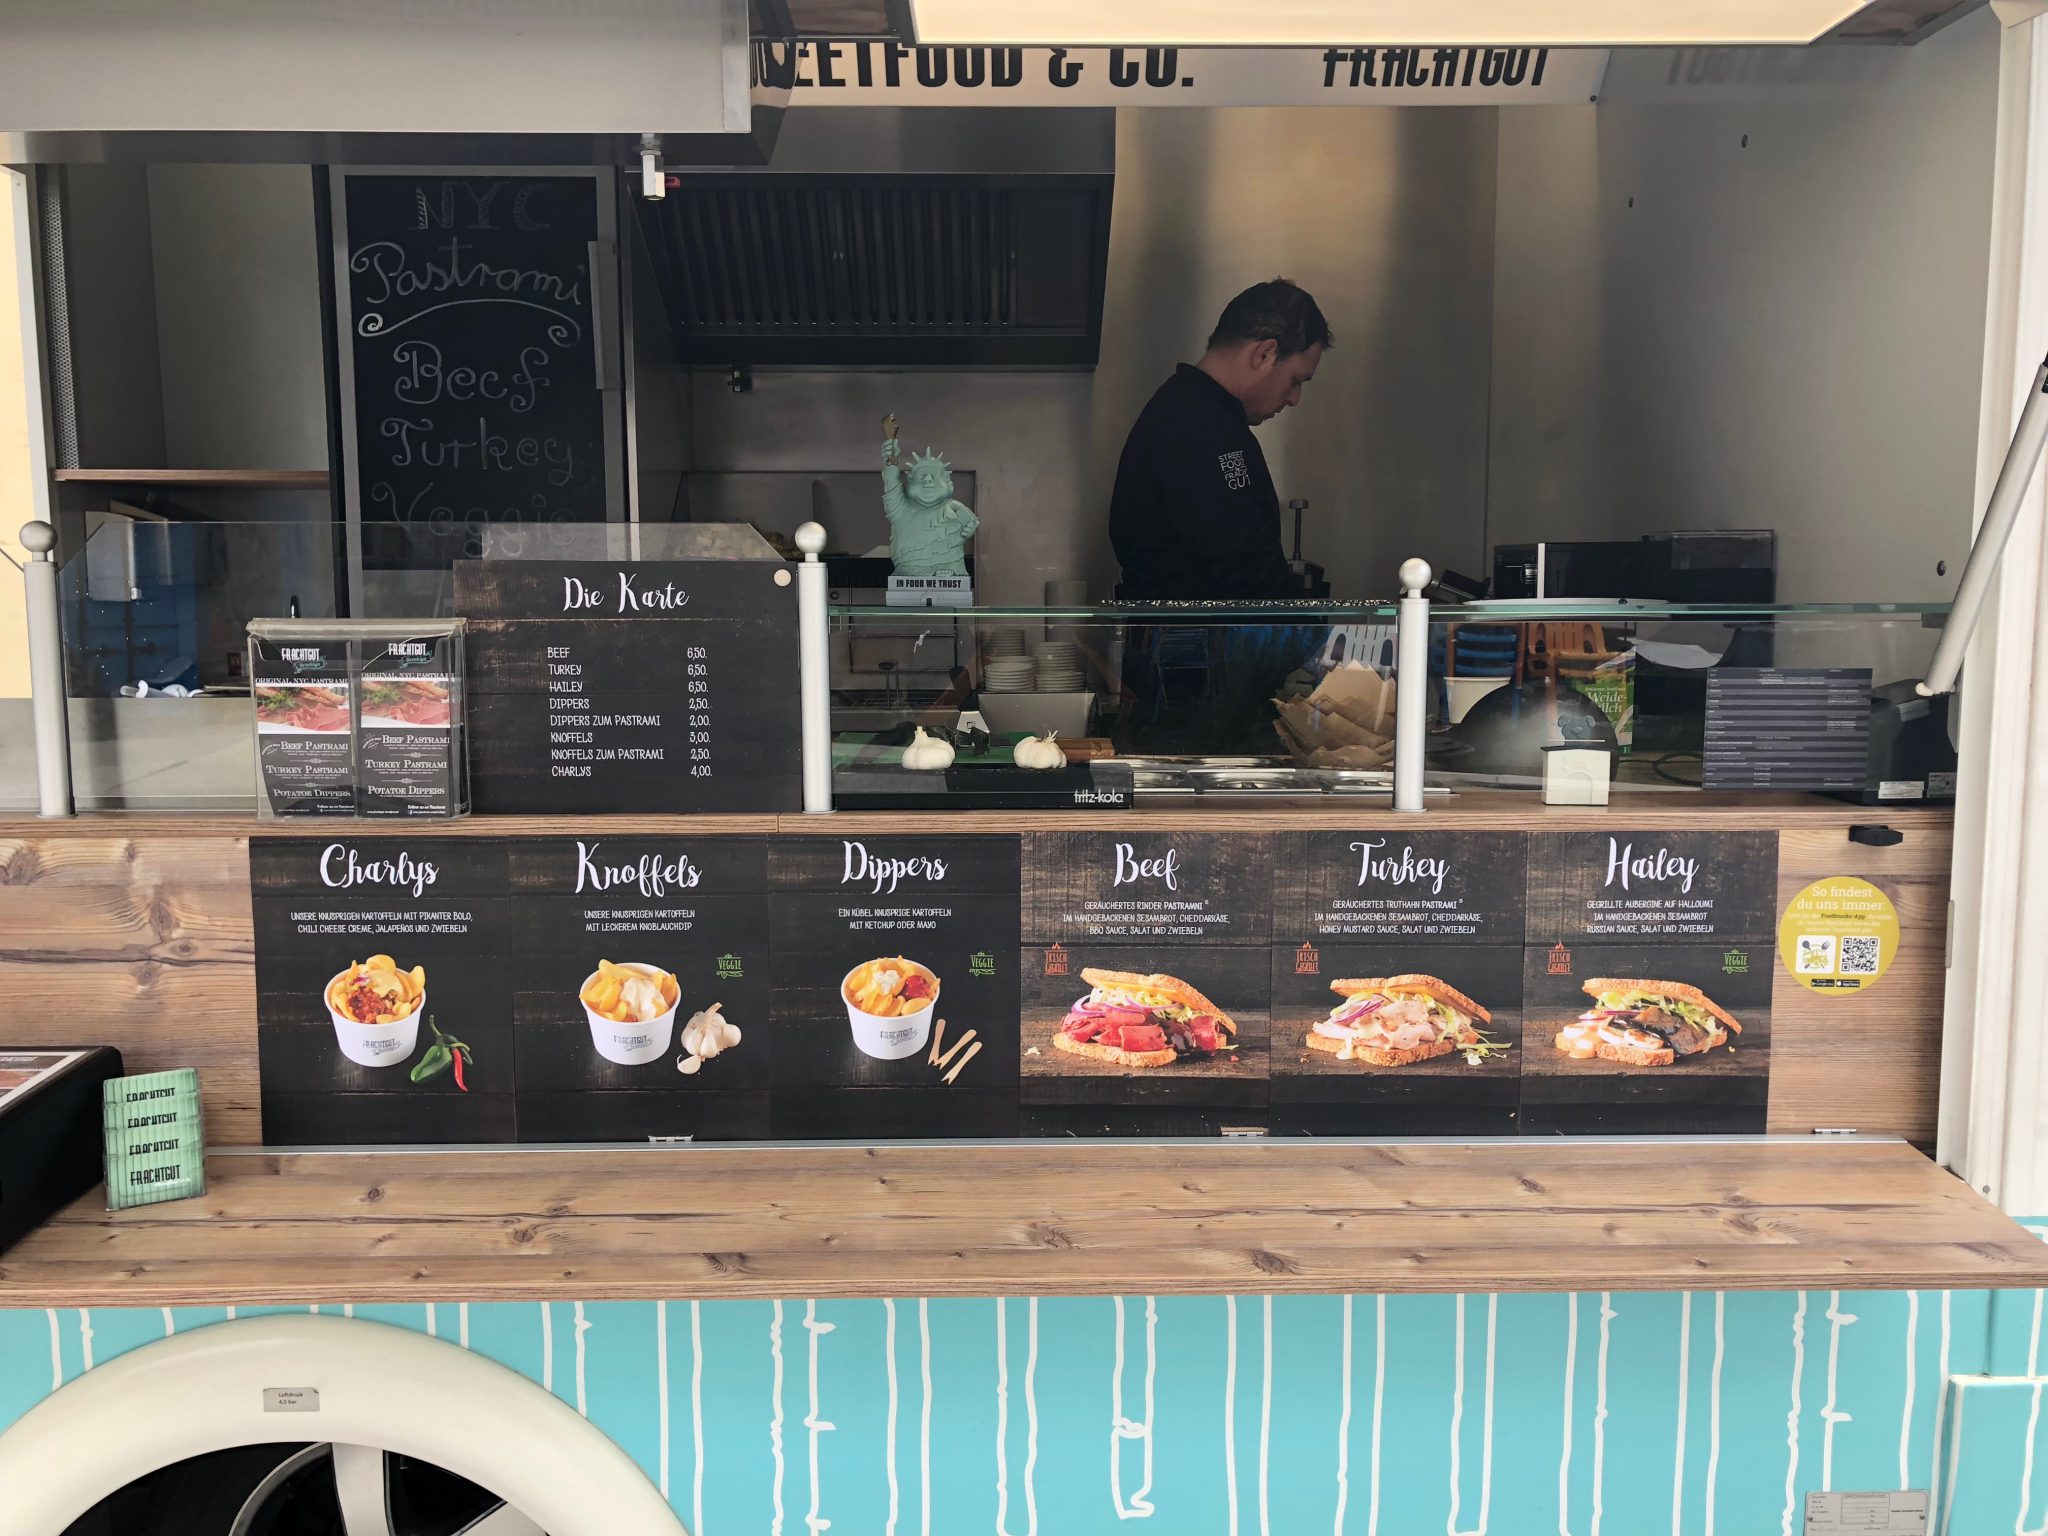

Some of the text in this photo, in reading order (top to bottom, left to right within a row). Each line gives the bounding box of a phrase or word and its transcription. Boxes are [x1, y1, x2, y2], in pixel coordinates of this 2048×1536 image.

[1048, 47, 1084, 88] &
[408, 181, 553, 231] NYC
[350, 236, 582, 305] Pastrami
[380, 415, 574, 487] Turkey
[896, 579, 961, 588] IN FOOD WE TRUST
[562, 571, 690, 613] Die Karte
[547, 647, 571, 659] BEEF
[548, 664, 582, 676] TURKEY
[549, 681, 583, 693] HAILEY
[1588, 691, 1627, 703] Weide-
[549, 698, 590, 710] DIPPERS
[1598, 702, 1622, 713] ilch
[550, 715, 591, 727] DIPPERS
[592, 715, 612, 727] ZUM
[615, 715, 661, 727] PASTRAMI
[382, 735, 404, 744] BEEF
[407, 735, 450, 744] PASTRAMI
[550, 732, 593, 744] KNOFFELS
[281, 741, 303, 750] BEEF
[305, 741, 348, 750] PASTRAMI
[551, 748, 594, 760] KNOFFELS
[596, 748, 616, 760] ZUM
[618, 748, 664, 760] PASTRAMI
[266, 765, 348, 774] TURKEY PASTRAMI
[365, 759, 447, 769] TURKEY PASTRAMI
[551, 765, 592, 777] CHARLYS
[368, 786, 445, 795] POTATOE DIPPERS
[575, 841, 702, 897] Knoffels
[841, 840, 948, 894] Dippers
[1113, 842, 1180, 891] Beef
[1349, 837, 1450, 894] Turkey
[1604, 836, 1700, 893] Hailey
[319, 843, 440, 898] Charlys
[1812, 886, 1873, 898] So findest
[1137, 901, 1162, 910] RINDER
[1386, 900, 1420, 909] TRUTHAHN
[1422, 900, 1457, 909] PASTRAMI
[1587, 900, 1624, 909] GEGRILLTE
[1625, 900, 1663, 909] AUBERGINE
[1664, 900, 1677, 909] AUF
[1797, 899, 1812, 910] du
[1816, 901, 1839, 910] uns
[291, 912, 317, 921] UNSERE
[318, 912, 360, 921] KNUSPRIGEN
[361, 912, 402, 920] KARTOFFELN
[404, 912, 418, 920] MIT
[419, 912, 452, 921] PIKANTER
[584, 910, 695, 919] UNSERE KNUSPRIGEN KARTOFFELN
[839, 909, 850, 917] EIN
[874, 909, 911, 917] KNUSPRIGE
[912, 908, 951, 917] KARTOFFELN
[1314, 913, 1324, 921] IM
[1326, 912, 1387, 921] HANDGEBACKENEN
[1594, 912, 1708, 921] IM HANDGEBACKENEN SESAMBROT
[1063, 914, 1073, 922] IM
[1074, 914, 1135, 923] HANDGEBACKENEN
[298, 925, 318, 933] CHILI
[320, 925, 347, 933] CHEESE
[415, 925, 430, 933] UND
[431, 924, 467, 933] ZWIEBELN
[586, 922, 692, 931] MIT LECKEREM KNOBLAUCHDIP
[850, 920, 937, 929] MIT KETCHUP ODER MAYO
[1319, 925, 1341, 934] HONEY
[1343, 925, 1375, 934] MUSTARD
[1402, 925, 1422, 934] SALAT
[1424, 925, 1438, 934] UND
[1440, 925, 1476, 934] ZWIEBELN
[1587, 924, 1615, 934] RUSSIAN
[1641, 924, 1661, 933] SALAT
[1663, 924, 1677, 933] UND
[1678, 924, 1714, 933] ZWIEBELN
[1089, 926, 1104, 935] BBQ
[1130, 926, 1150, 935] SALAT
[1152, 927, 1166, 935] UND
[1168, 926, 1203, 935] ZWIEBELN
[130, 1165, 181, 1186] FRACHTGUT
